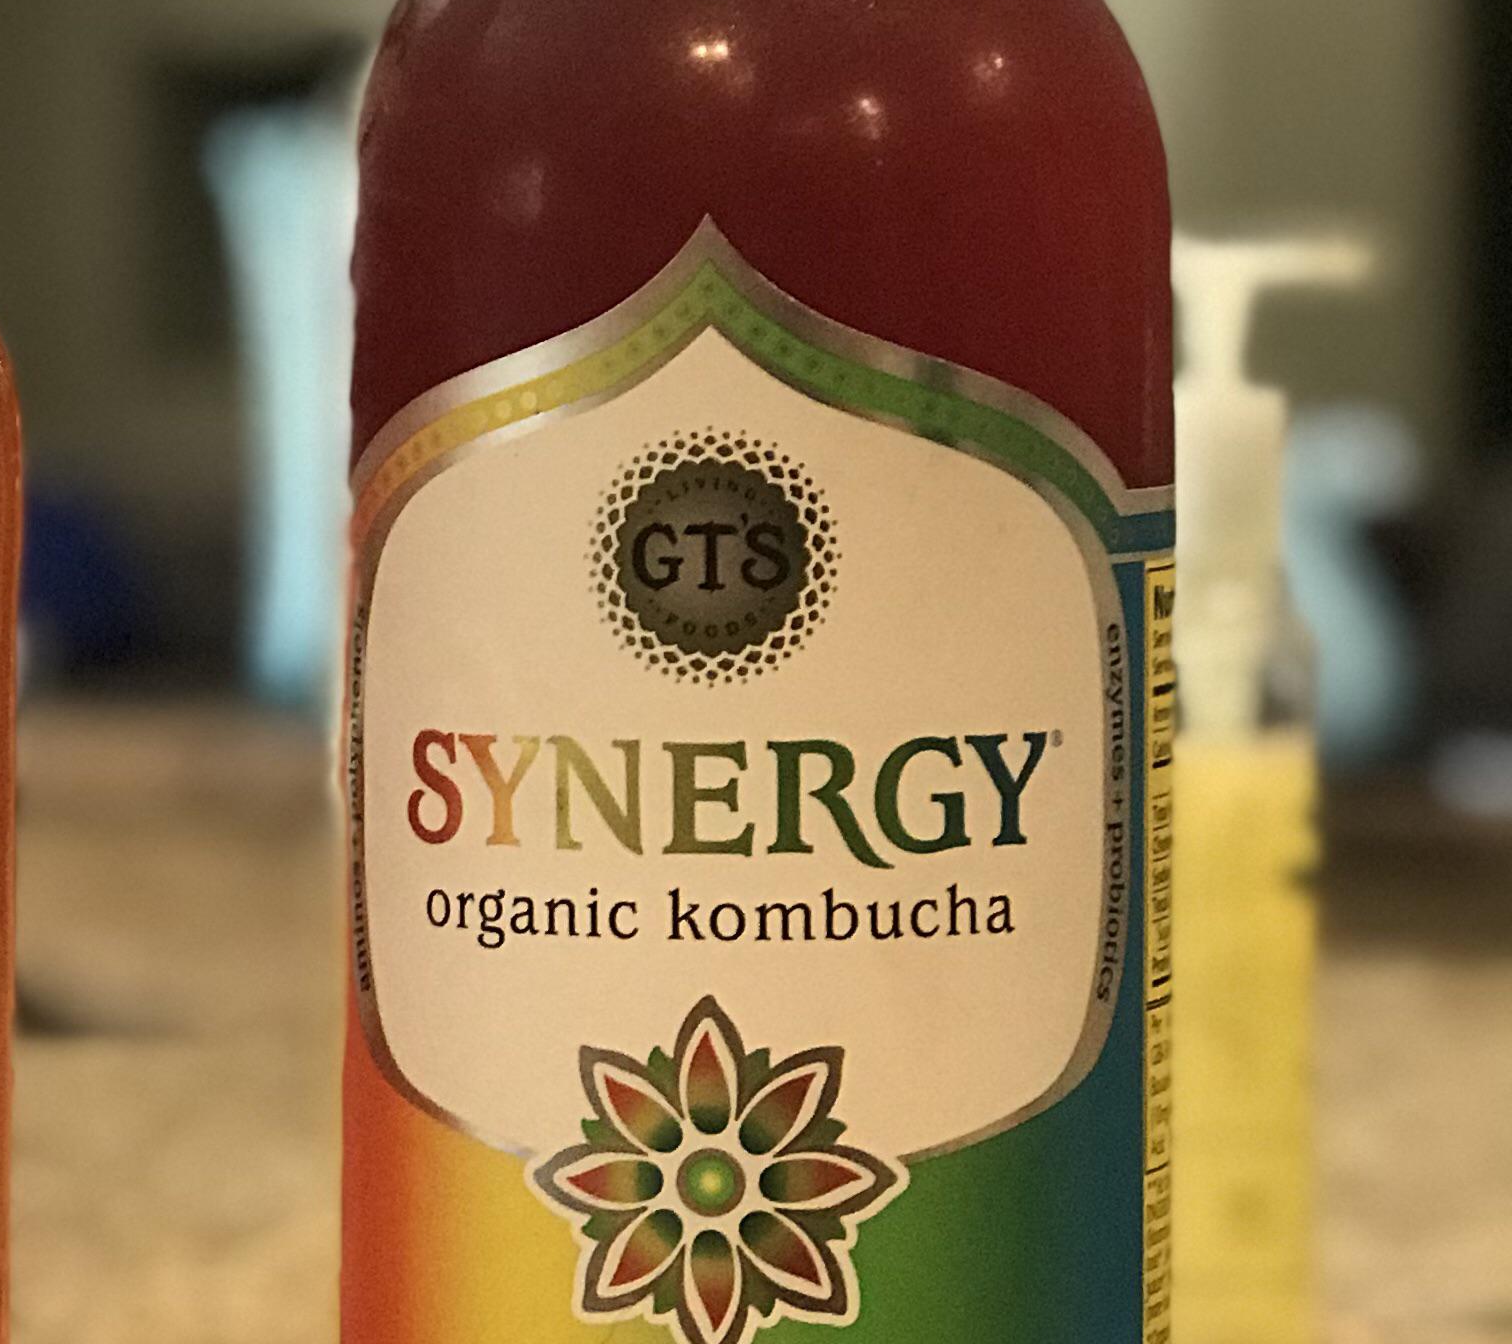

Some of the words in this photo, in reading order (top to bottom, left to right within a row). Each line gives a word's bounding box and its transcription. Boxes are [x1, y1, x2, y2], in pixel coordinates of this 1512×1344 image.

[632, 513, 791, 592] GT'S
[1104, 622, 1127, 782] enzymes
[425, 886, 639, 949] organic
[667, 882, 1015, 942] kombucha
[1096, 821, 1128, 1005] probiotics
